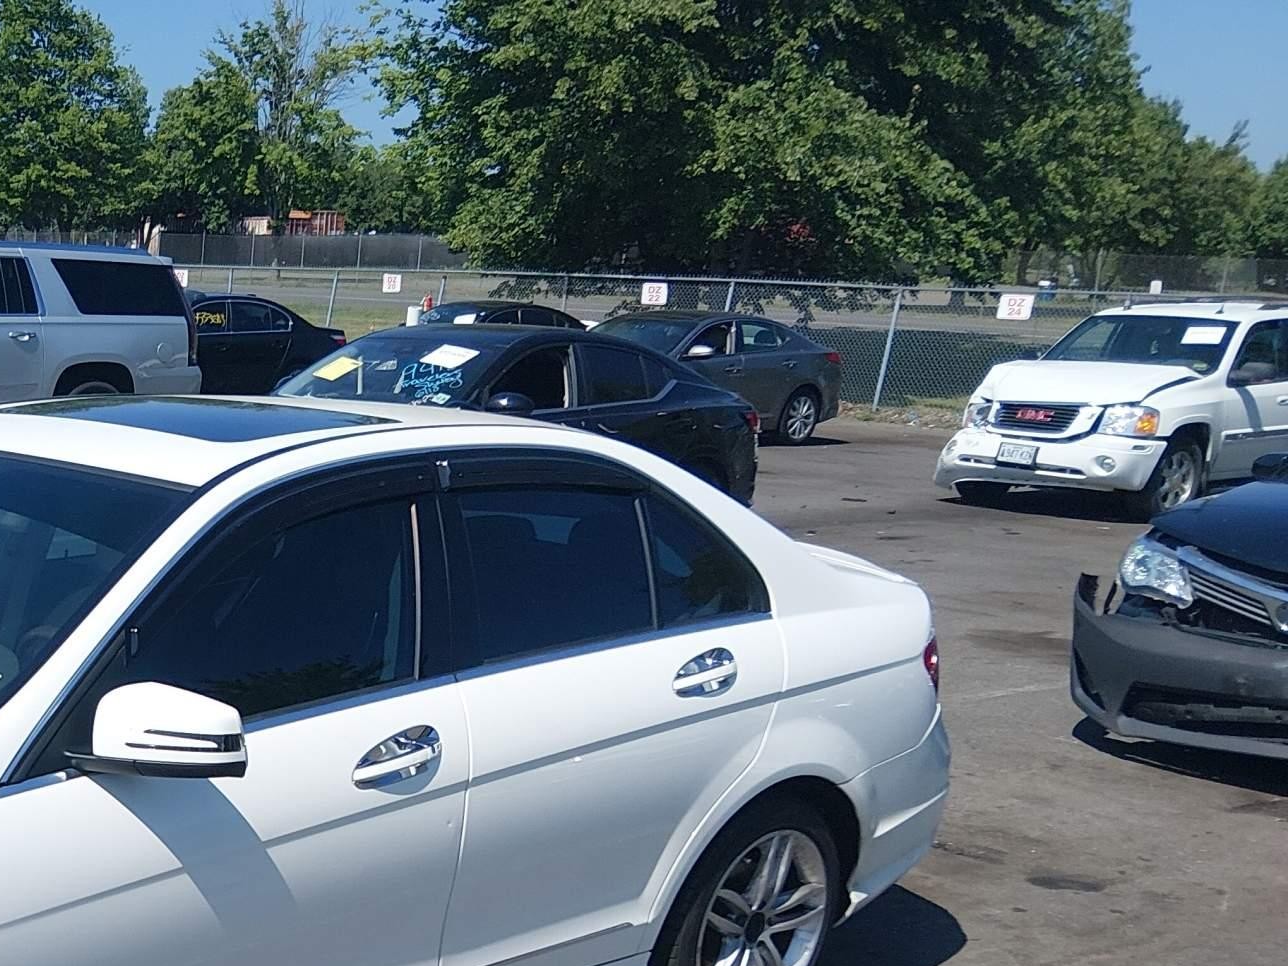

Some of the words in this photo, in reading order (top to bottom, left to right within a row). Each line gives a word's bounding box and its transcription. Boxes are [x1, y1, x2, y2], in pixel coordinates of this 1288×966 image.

[648, 286, 663, 294] DZ
[1008, 298, 1027, 308] DZ
[1007, 307, 1023, 316] 24
